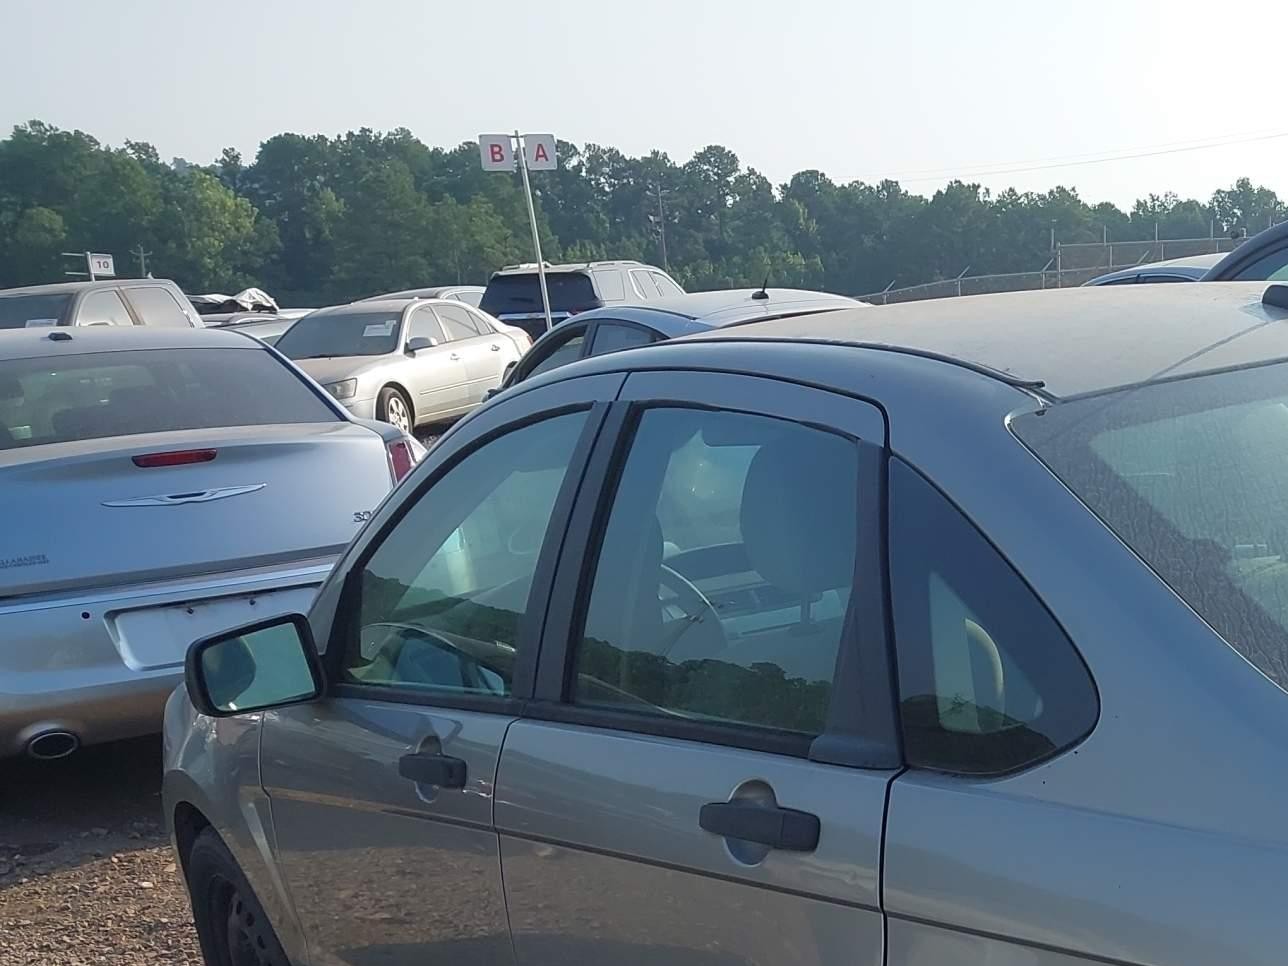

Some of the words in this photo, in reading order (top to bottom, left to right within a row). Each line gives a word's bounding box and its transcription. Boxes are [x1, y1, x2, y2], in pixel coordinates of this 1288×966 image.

[489, 144, 505, 162] B
[535, 143, 549, 162] A
[96, 260, 110, 269] 10
